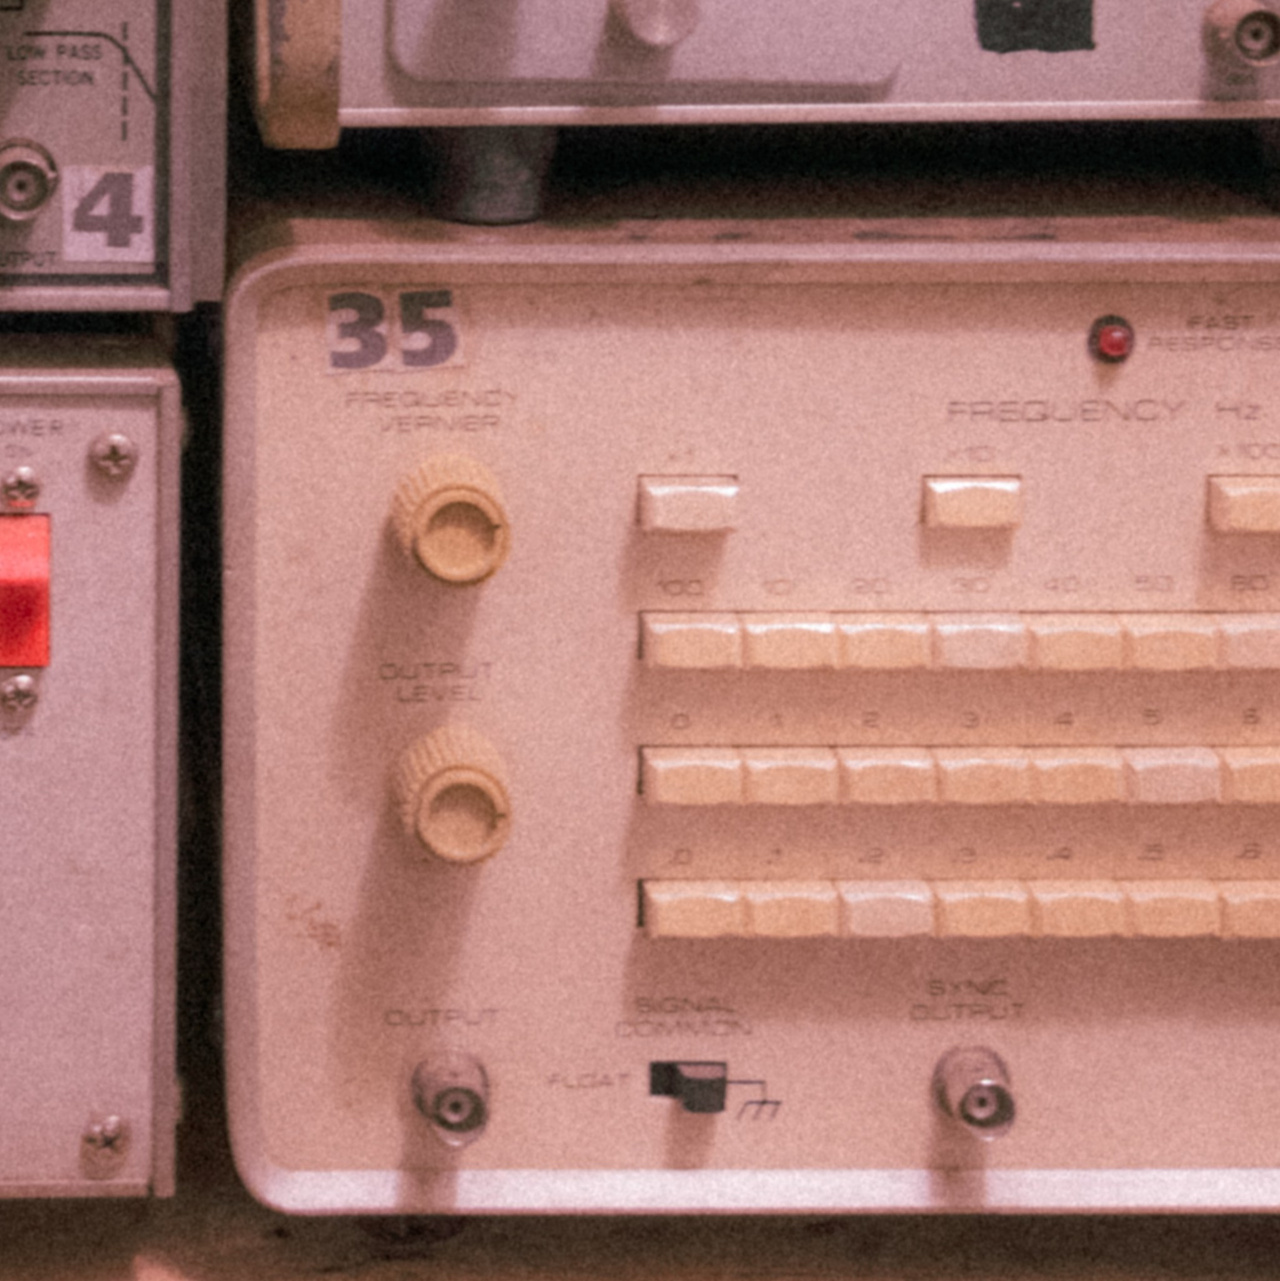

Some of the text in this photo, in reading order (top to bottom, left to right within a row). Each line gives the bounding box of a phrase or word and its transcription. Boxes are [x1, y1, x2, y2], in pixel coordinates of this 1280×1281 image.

[7, 44, 103, 61] LOW PASS
[17, 69, 95, 87] SECTION
[72, 171, 144, 248] 4
[327, 289, 459, 369] 35
[1186, 315, 1255, 330] FAST
[345, 389, 518, 408] FREQUENCY
[947, 399, 1186, 422] FREQUENCY
[379, 662, 492, 681] OUTPUT
[397, 685, 481, 703] LEVEL
[927, 980, 1009, 997] SYNC
[635, 996, 736, 1014] SIGNAL
[909, 1004, 1024, 1022] OUTPUT
[384, 1008, 500, 1026] OUTPUT
[615, 1019, 754, 1038] COMMON
[546, 1072, 630, 1088] FLOAT
